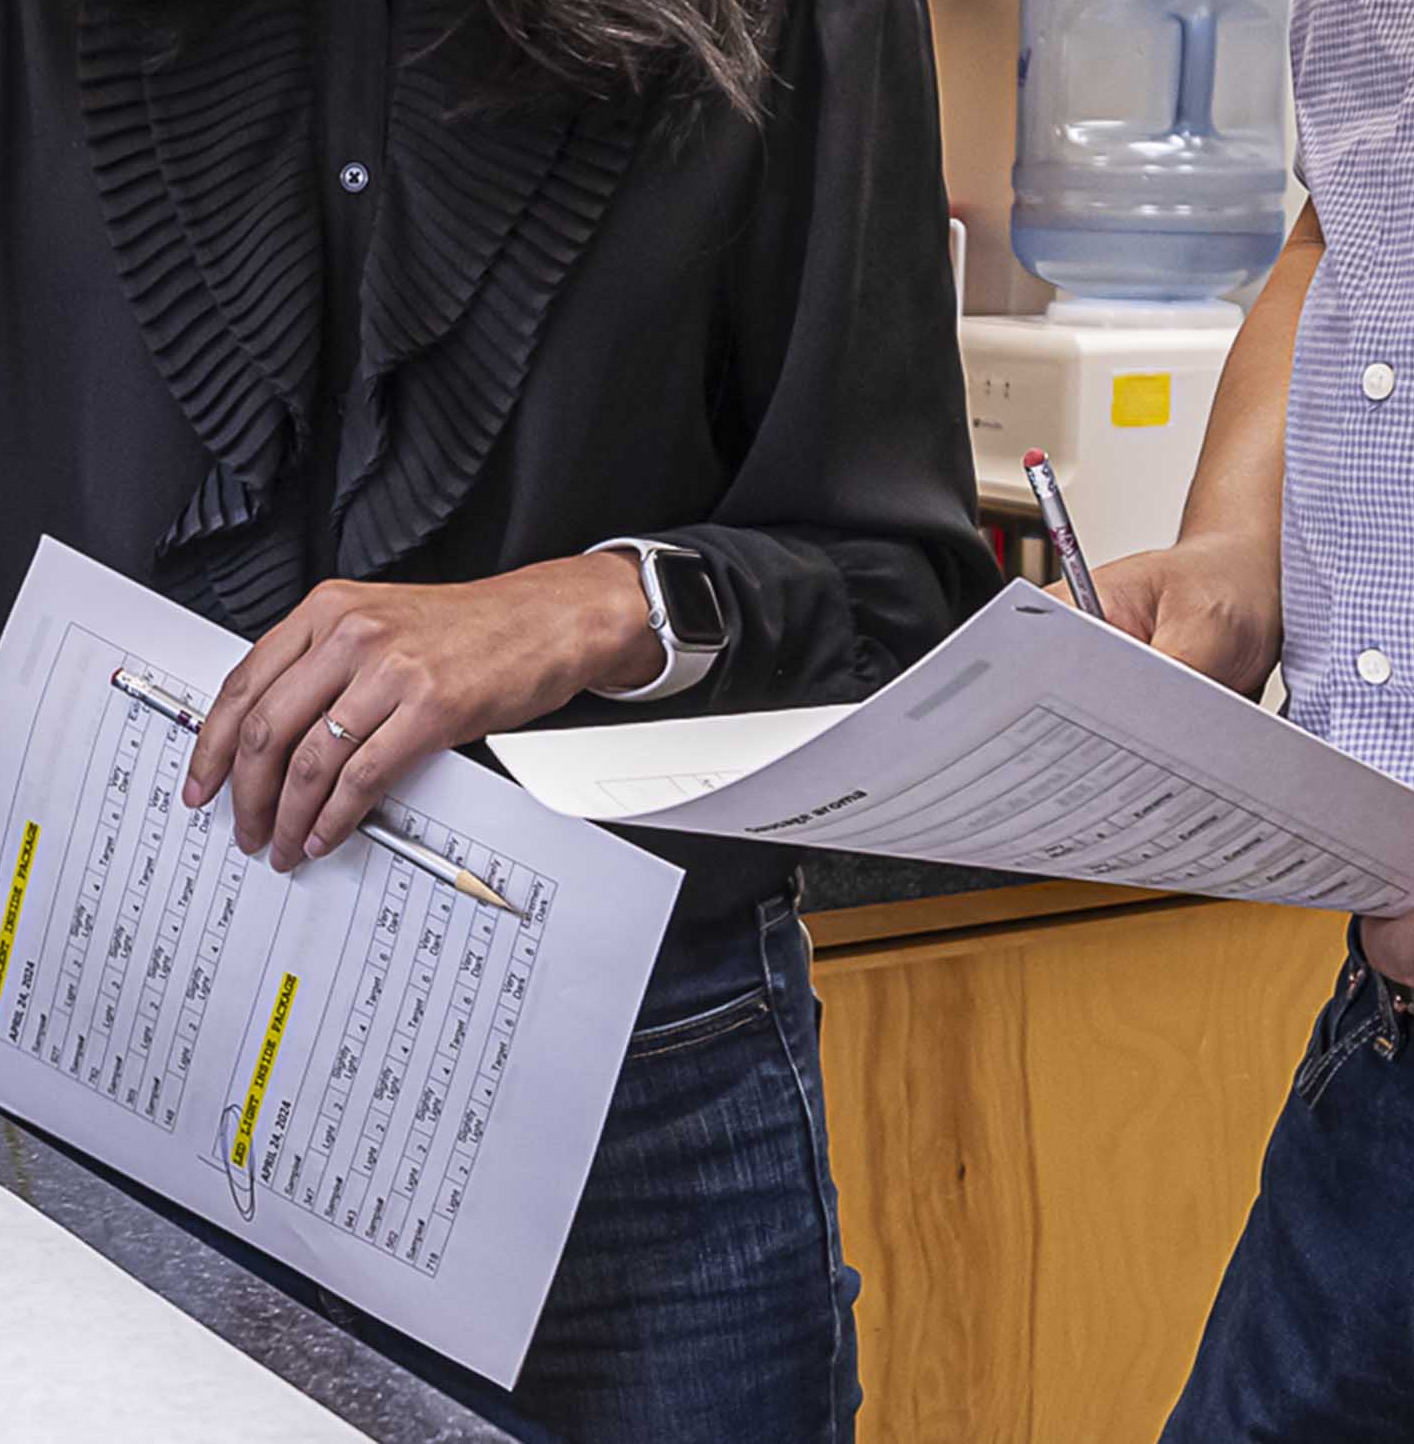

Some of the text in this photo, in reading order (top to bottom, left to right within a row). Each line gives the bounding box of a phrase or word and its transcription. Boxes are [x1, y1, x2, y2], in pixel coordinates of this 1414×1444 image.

[3, 884, 25, 934] INSIDE
[17, 822, 40, 880] PACKAGE
[63, 982, 78, 1008] Light
[80, 912, 95, 939] Light
[98, 834, 117, 868] Target
[117, 769, 131, 793] Dark
[69, 764, 124, 938] Slightly Very
[107, 784, 164, 959] Slightly Very
[811, 788, 868, 818] aroma
[101, 1004, 117, 1030] Light
[119, 933, 134, 959] Light
[137, 854, 156, 889] Target
[157, 788, 172, 814] Dark
[139, 1024, 154, 1050] Light
[157, 954, 174, 980] Light
[177, 875, 196, 909] Target
[198, 809, 212, 833] Dark
[146, 944, 165, 980] Slightly
[177, 1045, 193, 1072] Light
[196, 974, 213, 1001] Light
[217, 895, 236, 930] Target
[185, 964, 204, 1001] Slightly
[331, 905, 393, 1080] Slightly Very
[6, 959, 37, 1043] APRIL 24, 2024
[240, 1094, 261, 1137] LIGHT
[255, 1040, 277, 1088] INSIDE
[273, 973, 297, 1033] PACKAGE
[321, 1124, 338, 1151] Light
[343, 1053, 360, 1081] Light
[365, 975, 384, 1008] Target
[386, 910, 400, 934] Dark
[362, 1145, 379, 1172] Light
[385, 1074, 401, 1102] Light
[407, 996, 427, 1030] Target
[428, 931, 443, 956] Dark
[372, 927, 434, 1102] Slightly Very
[404, 1166, 421, 1194] Light
[427, 1096, 443, 1123] Light
[449, 1018, 468, 1052] Target
[469, 953, 485, 978] Dark
[414, 948, 476, 1123] Slightly Very
[445, 1187, 462, 1215] Light
[469, 1117, 485, 1144] Light
[490, 1040, 510, 1074] Target
[512, 974, 527, 1000] Dark
[534, 897, 549, 923] Dark
[456, 1106, 477, 1144] Slightly
[502, 970, 518, 996] Very
[259, 1099, 292, 1183] APRIL 24, 2024
